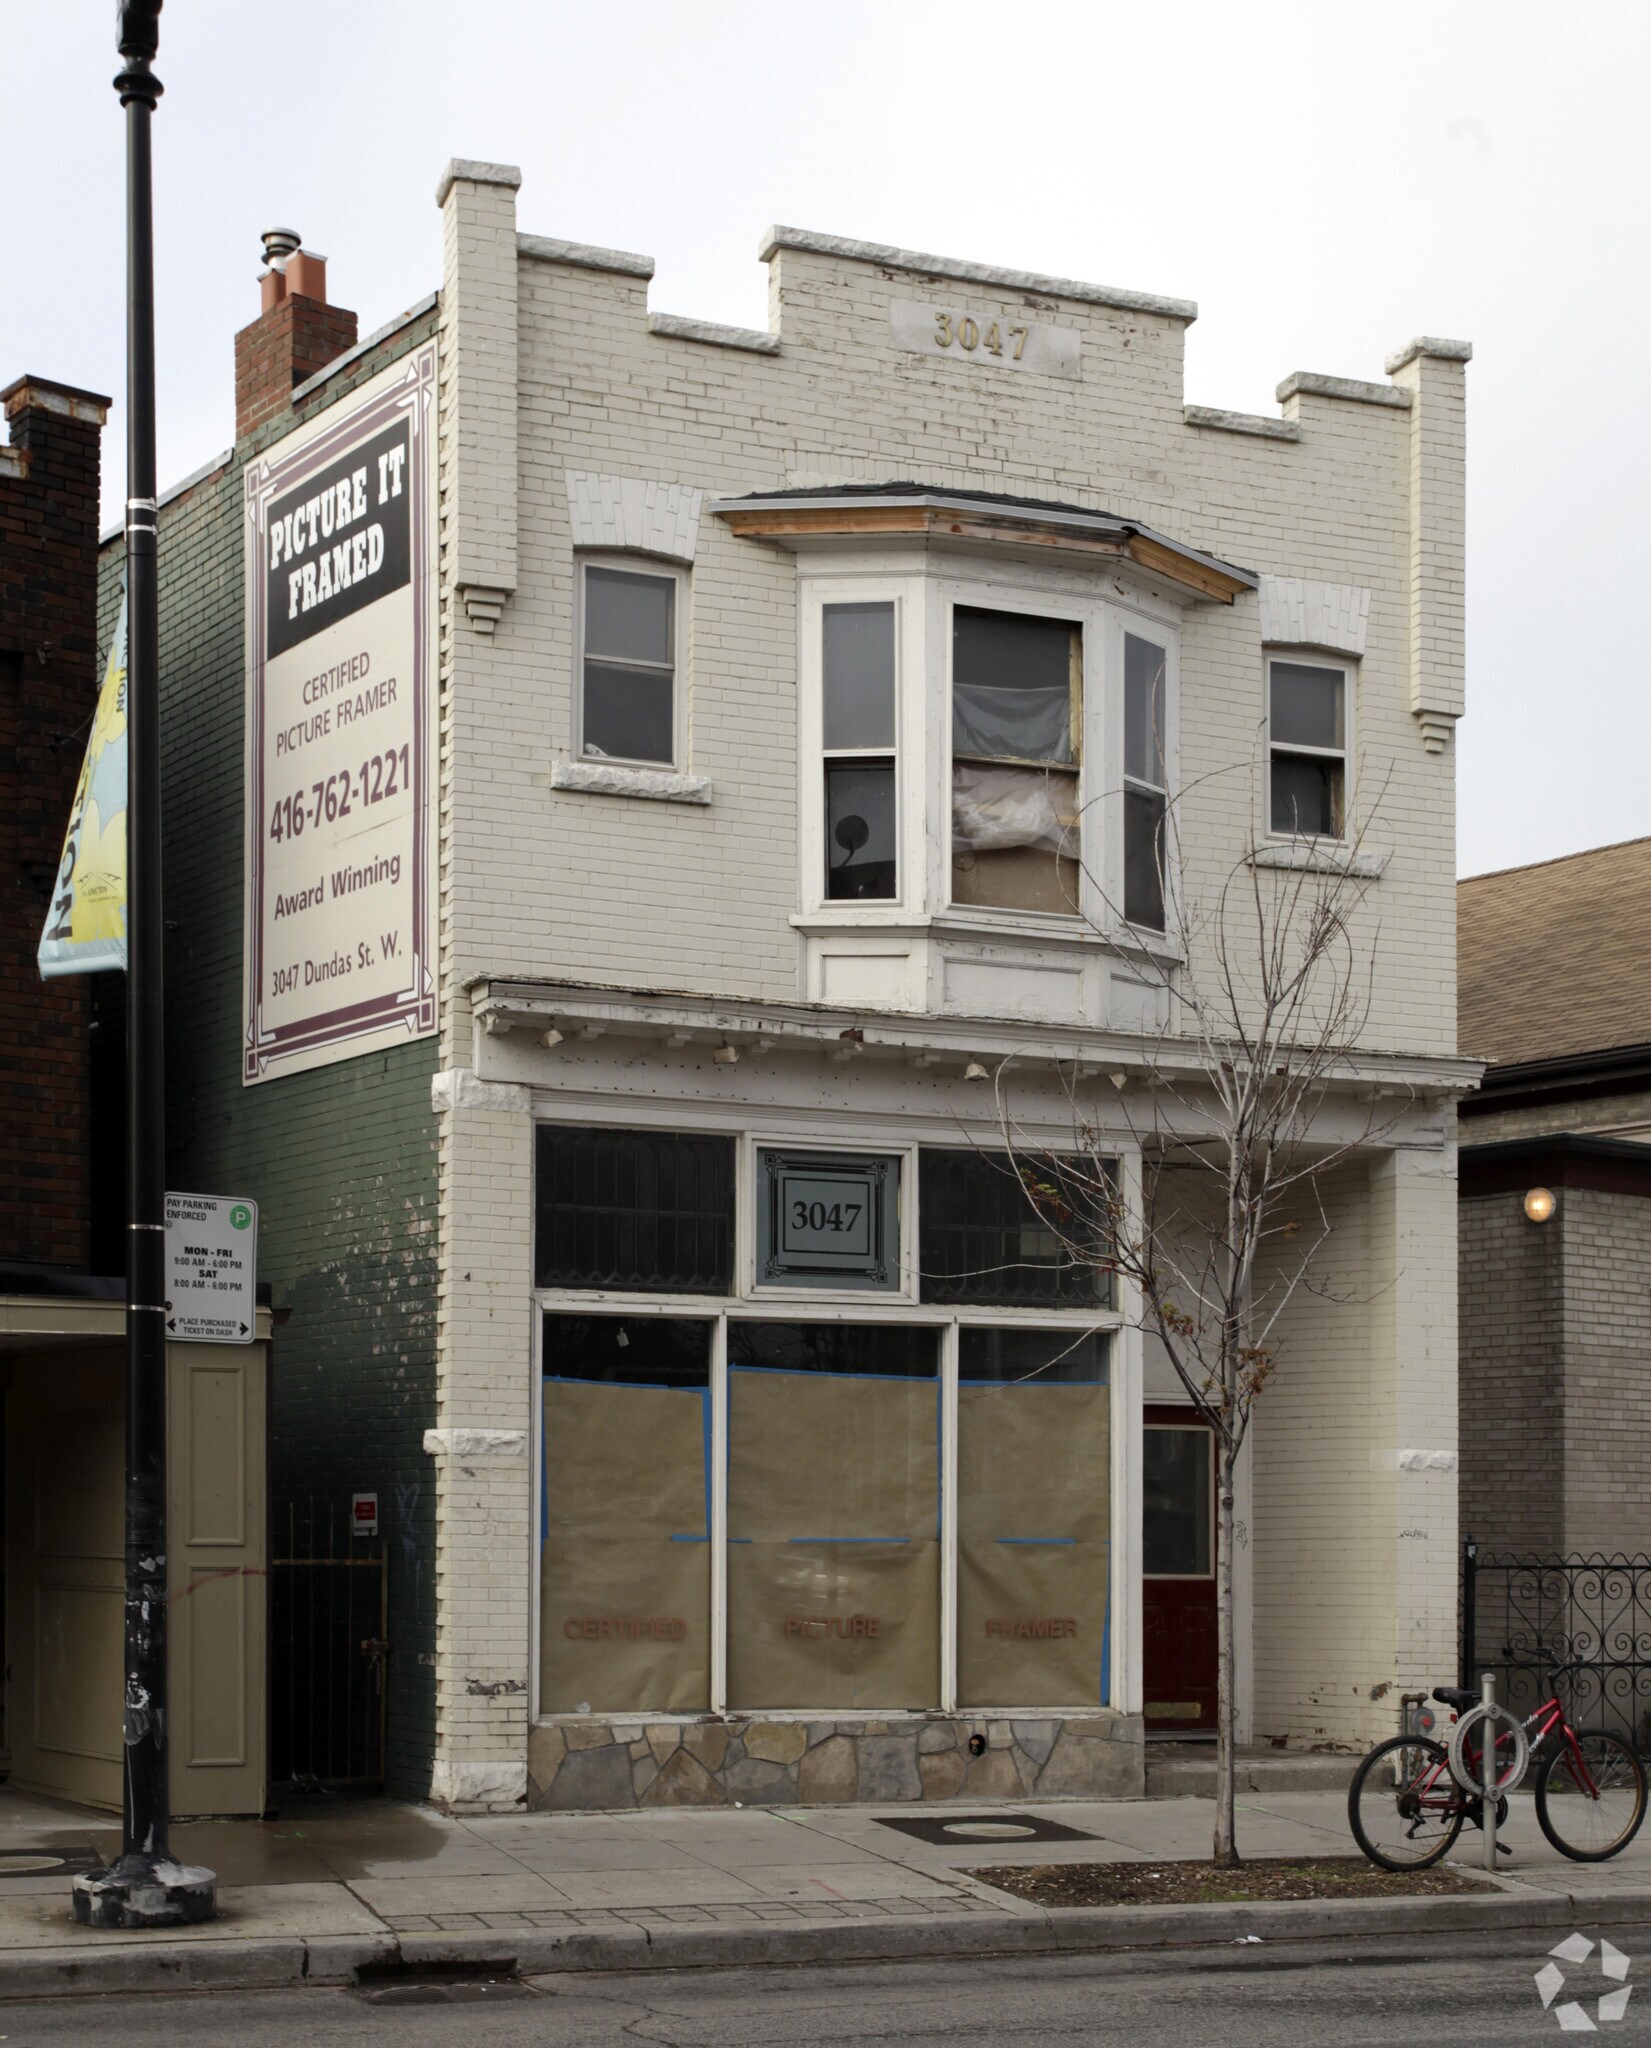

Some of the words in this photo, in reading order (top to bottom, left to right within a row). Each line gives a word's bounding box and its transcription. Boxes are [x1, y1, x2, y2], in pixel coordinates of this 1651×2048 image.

[934, 312, 1029, 360] 3047
[270, 466, 367, 570] PICTURE
[378, 443, 405, 505] IT
[288, 523, 384, 620] FRAMED
[303, 651, 370, 705] CERTIFIED
[276, 709, 331, 757] PICTURE
[336, 677, 398, 728] FRAMER
[270, 743, 410, 844] 416-762-1221
[274, 876, 324, 921] Award
[331, 854, 401, 898] Winning
[272, 964, 299, 997] 3047
[304, 951, 351, 987] Dundas
[358, 942, 375, 971] St.
[380, 931, 402, 960] W.
[166, 1199, 181, 1209] PAY
[183, 1200, 217, 1211] PARKING
[166, 1210, 207, 1221] ENFORCED
[791, 1201, 862, 1232] 3047
[174, 1257, 189, 1266] 9:00
[192, 1258, 205, 1267] AM
[230, 1260, 242, 1269] PM
[184, 1246, 208, 1256] MON
[216, 1249, 232, 1258] FRI
[192, 1280, 205, 1289] AM
[230, 1282, 242, 1291] PM
[199, 1269, 218, 1279] SAT
[179, 1318, 198, 1326] PLACE
[200, 1319, 236, 1328] PURCHASED
[183, 1326, 204, 1335] TICKET
[205, 1327, 215, 1335] ON
[215, 1328, 233, 1336] DASH
[564, 1617, 688, 1641] CERTIFIED
[784, 1616, 880, 1639] PICTURE
[987, 1617, 1078, 1639] FRAMER
